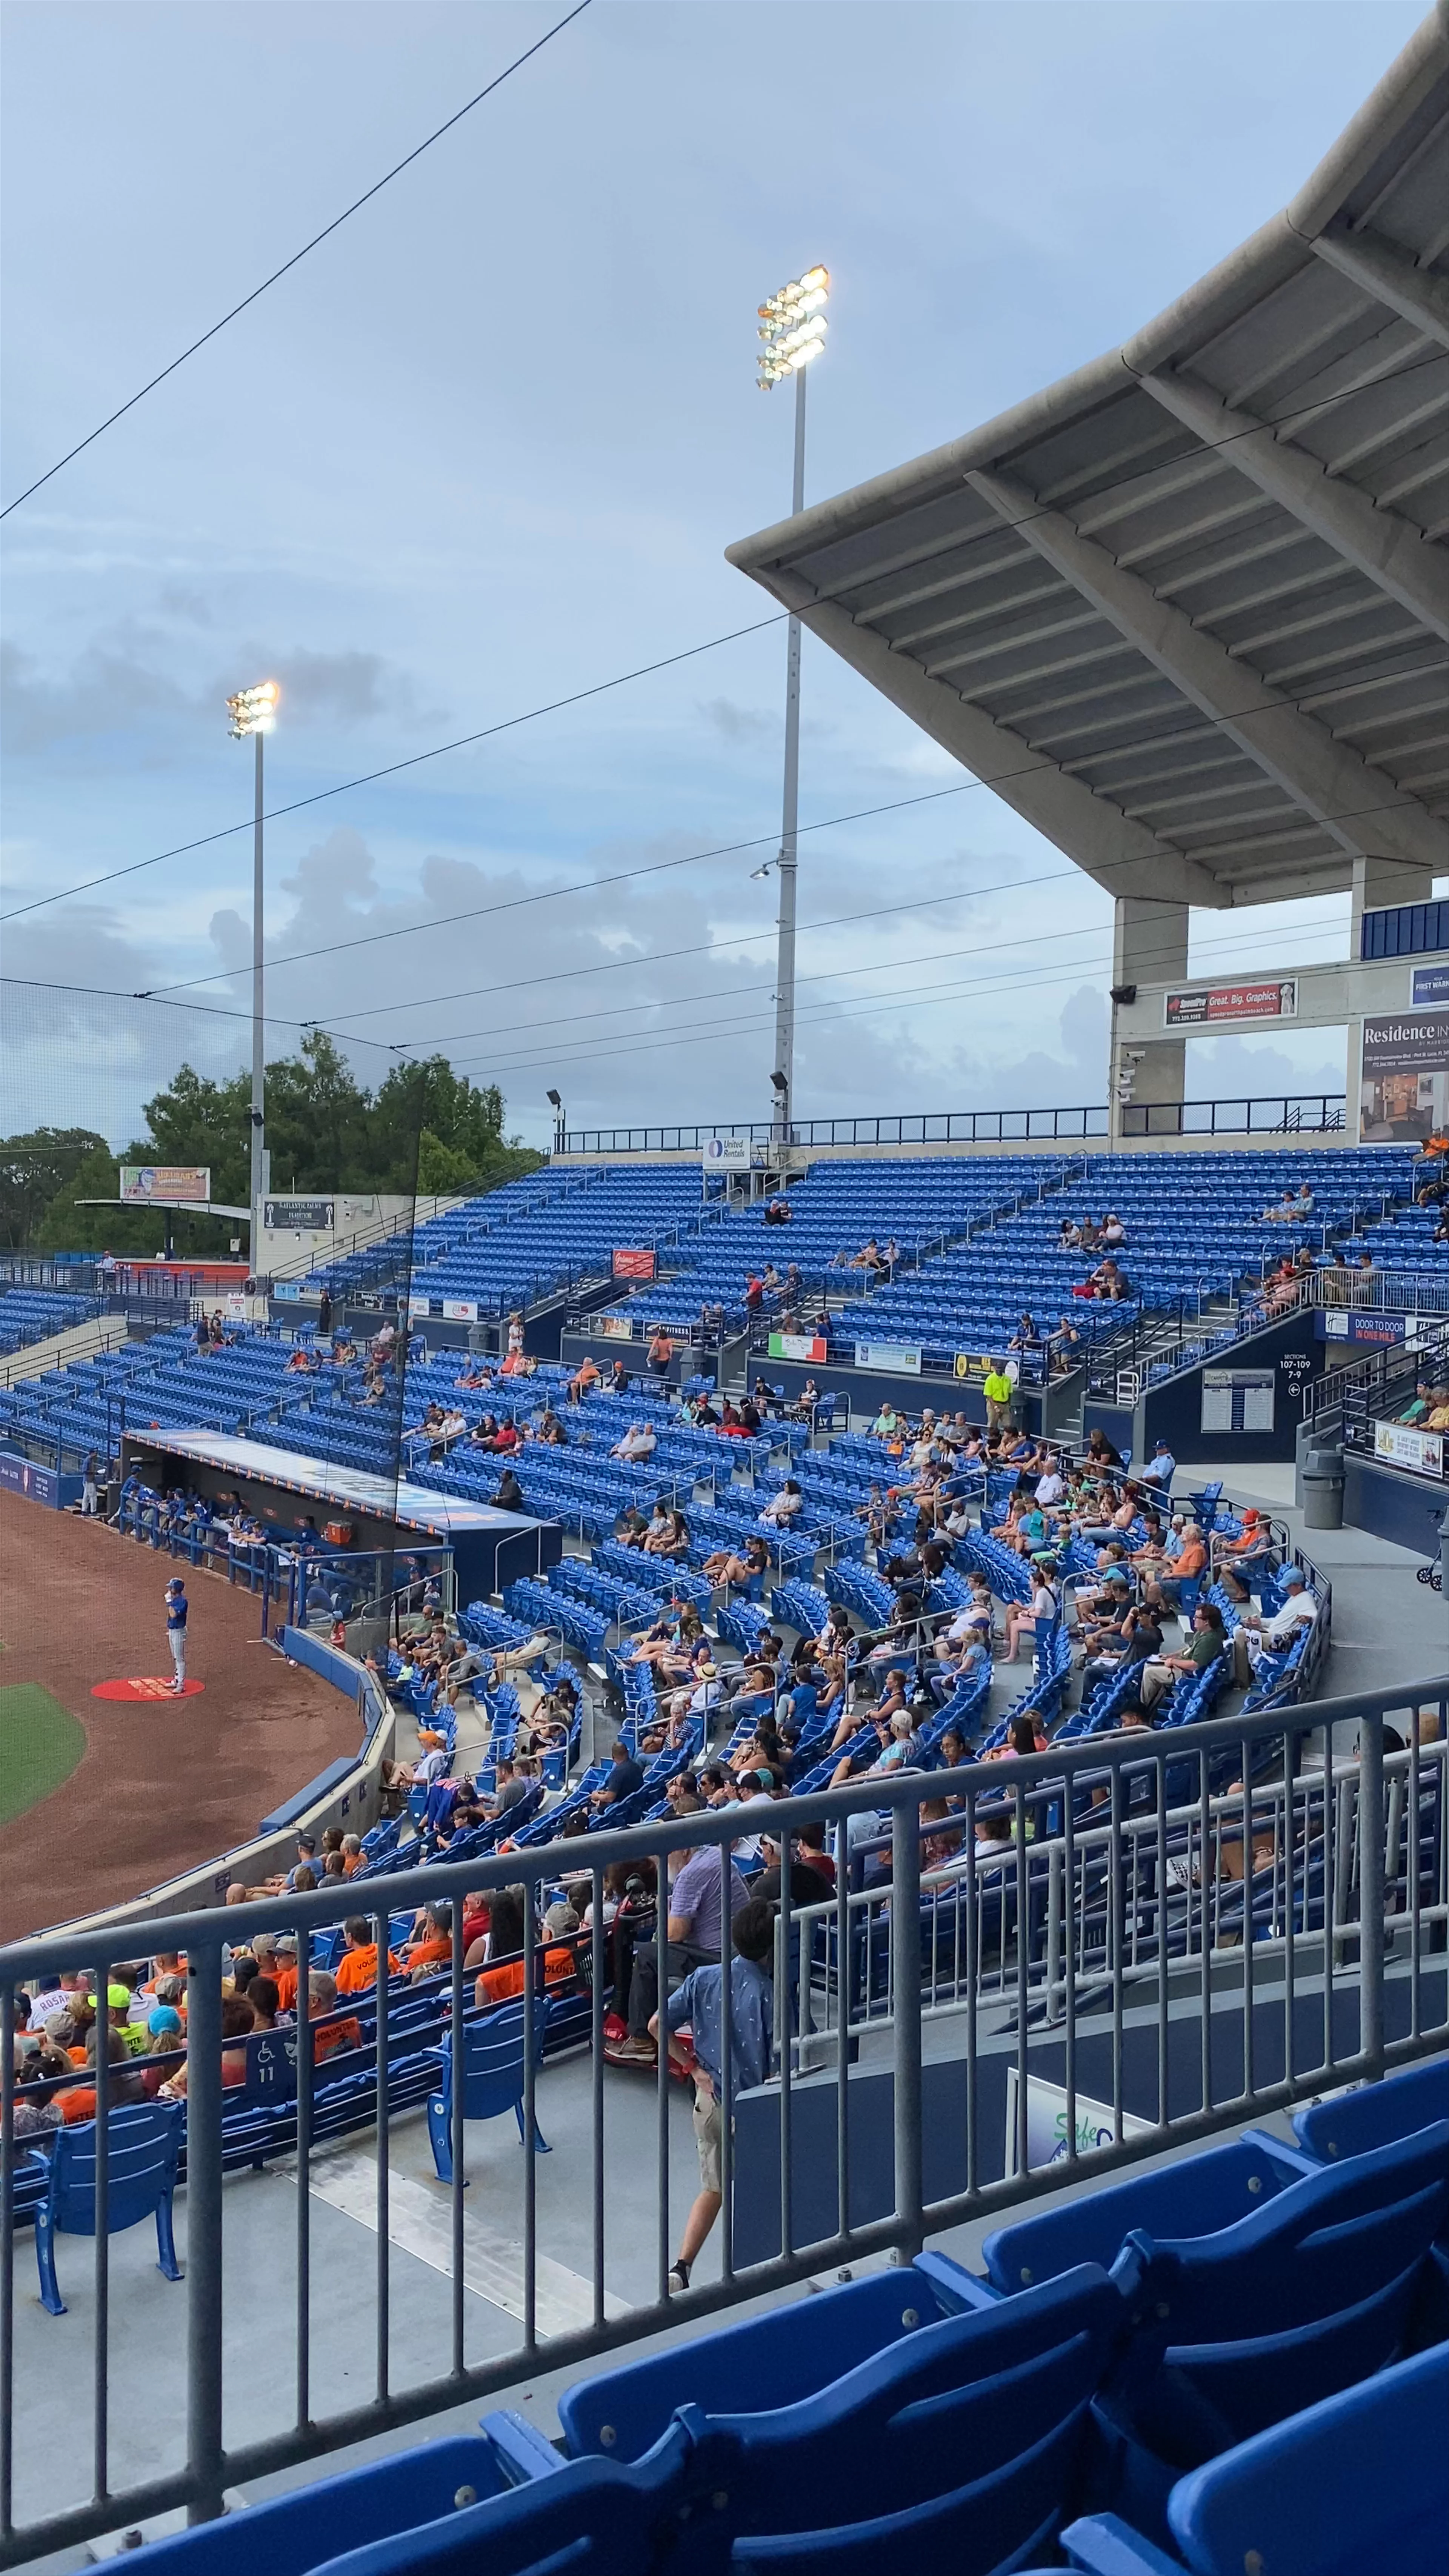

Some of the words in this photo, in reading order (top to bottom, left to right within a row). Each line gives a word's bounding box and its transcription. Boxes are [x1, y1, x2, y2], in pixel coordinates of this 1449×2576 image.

[1416, 982, 1432, 990] FIRST
[1209, 996, 1229, 1006] Great.
[1231, 994, 1244, 1005] Big.
[1246, 990, 1277, 1004] Graphics.
[1365, 1025, 1435, 1044] Residence
[724, 1140, 743, 1148] United
[723, 1149, 745, 1158] Rentals
[1355, 1318, 1374, 1329] DOOR
[1375, 1321, 1384, 1330] TO
[1384, 1321, 1404, 1333] DOOR
[1363, 1330, 1378, 1340] ONE
[1379, 1331, 1395, 1342] MILE
[1280, 1361, 1311, 1369] 107-109
[259, 2067, 274, 2083] 11
